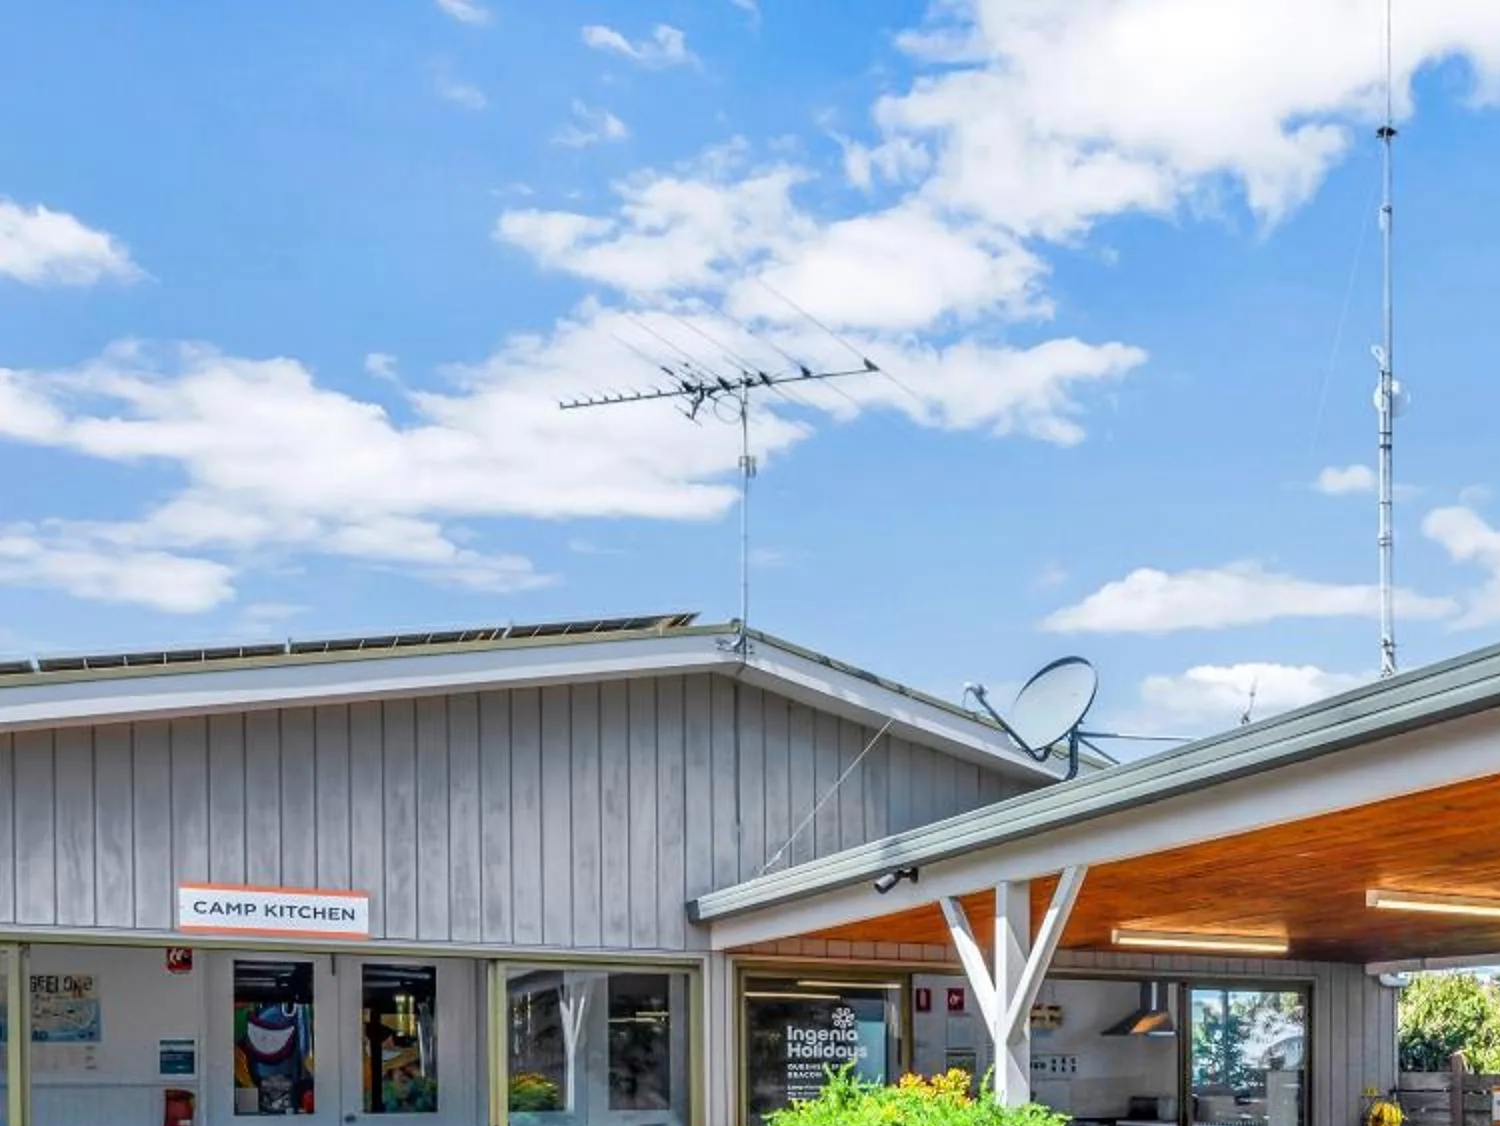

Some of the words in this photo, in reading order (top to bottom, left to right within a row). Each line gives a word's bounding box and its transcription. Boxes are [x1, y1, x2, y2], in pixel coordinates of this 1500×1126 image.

[193, 900, 256, 917] CAMP
[264, 903, 356, 922] KITCHEN
[787, 1025, 858, 1045] Ingenia
[787, 1041, 867, 1061] Holidays
